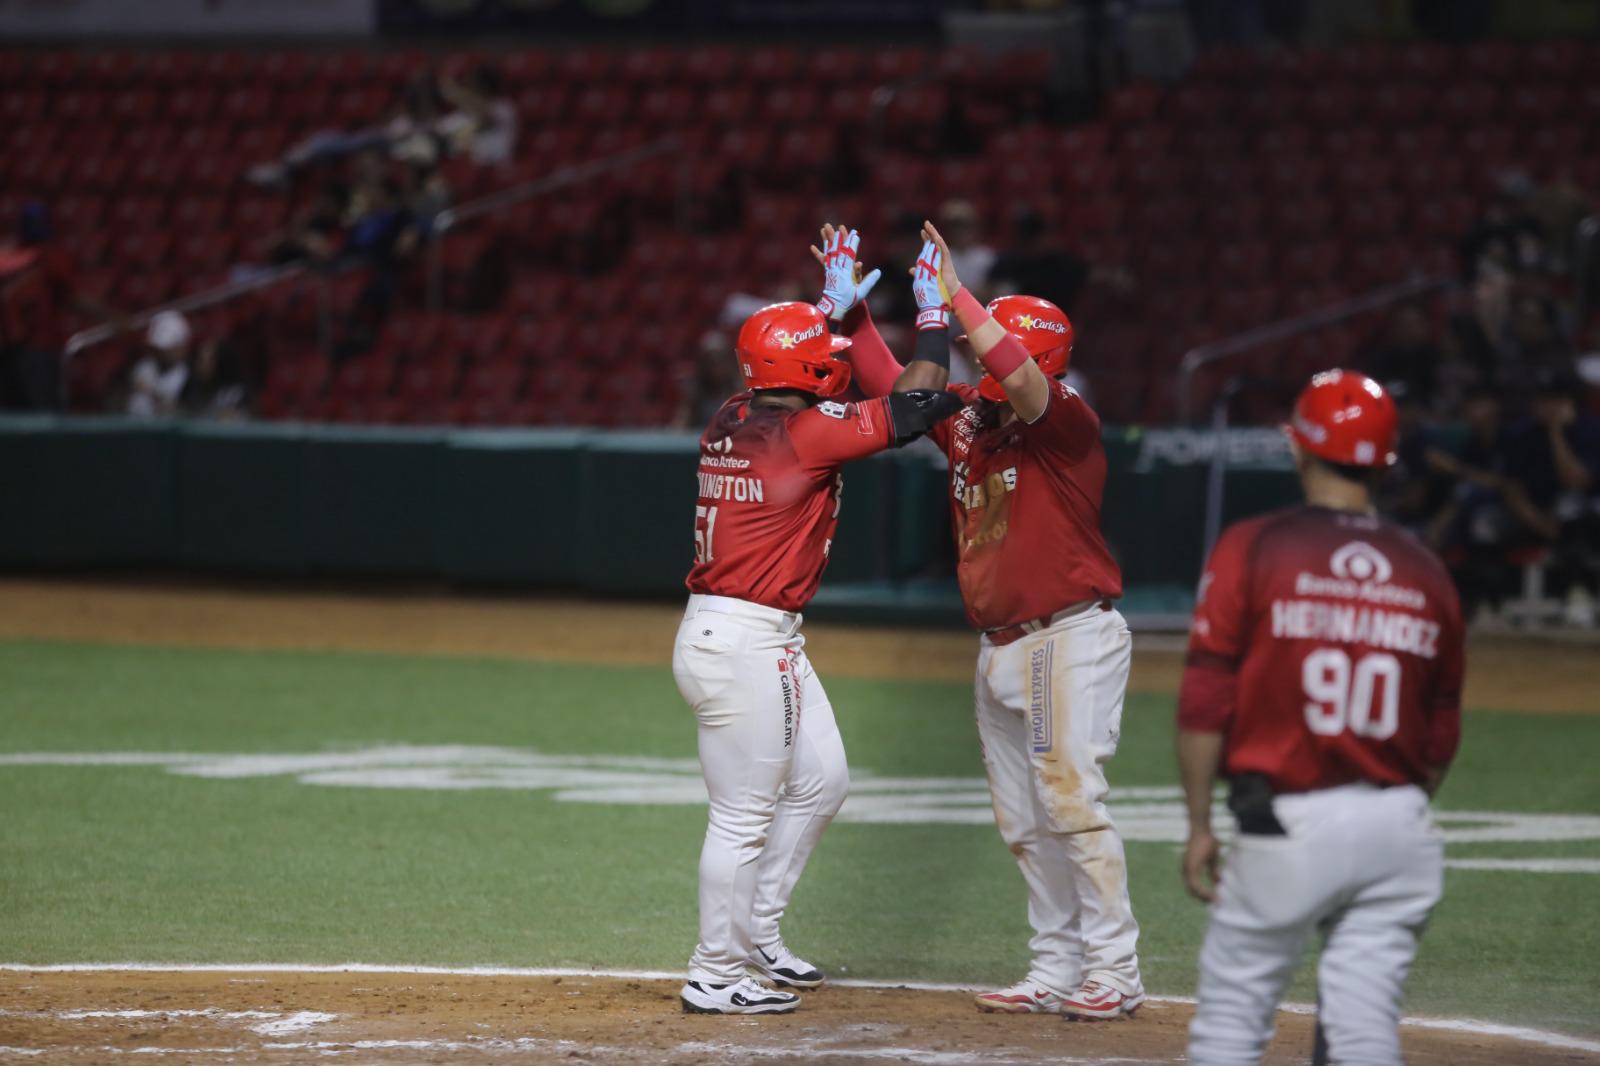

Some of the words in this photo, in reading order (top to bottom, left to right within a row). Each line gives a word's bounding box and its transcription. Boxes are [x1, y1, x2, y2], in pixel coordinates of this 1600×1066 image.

[720, 455, 751, 469] Azteca
[694, 505, 718, 565] 51
[1271, 598, 1440, 660] HERNANDEZ
[780, 674, 794, 748] caliente.mx
[1031, 647, 1045, 741] PAQUETEXPRESS
[1302, 646, 1401, 742] 90
